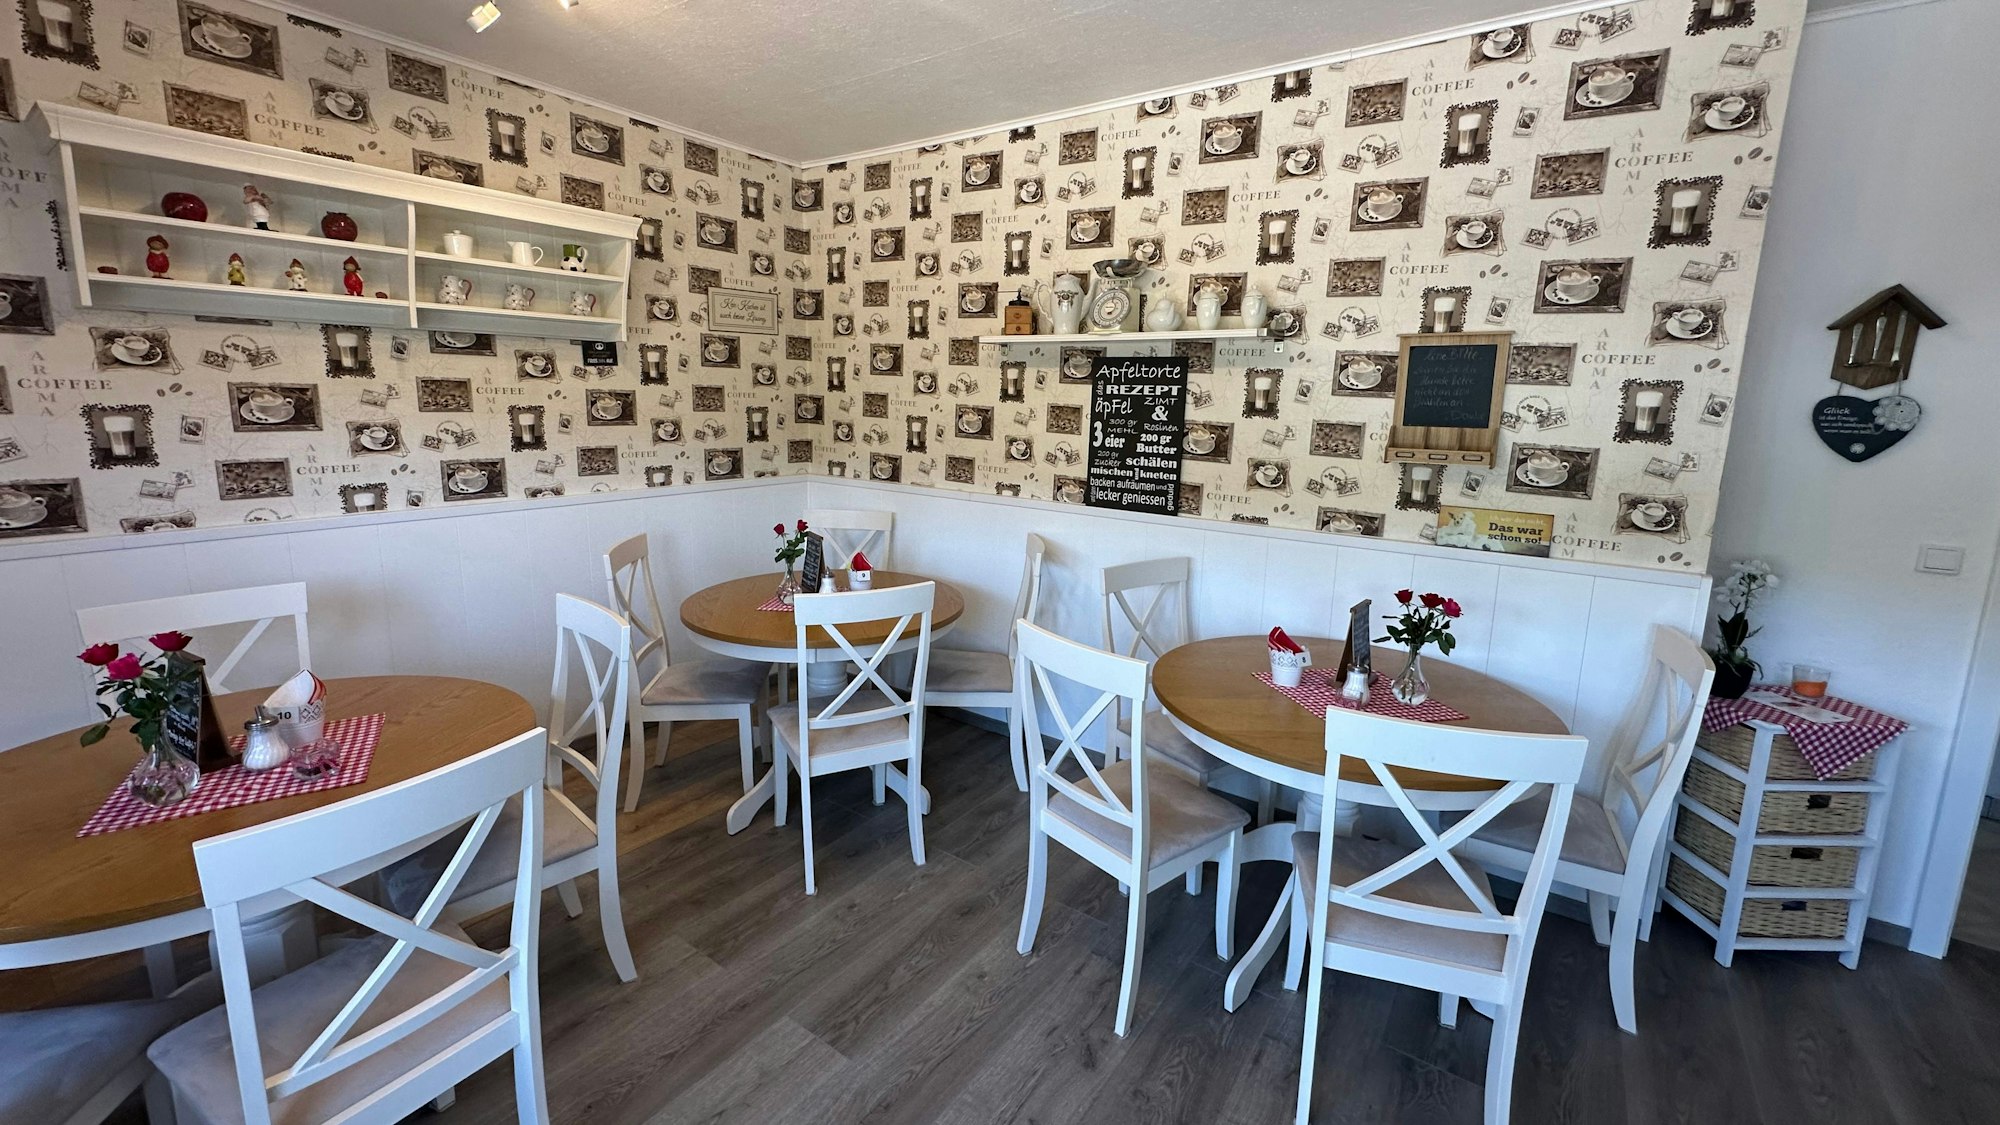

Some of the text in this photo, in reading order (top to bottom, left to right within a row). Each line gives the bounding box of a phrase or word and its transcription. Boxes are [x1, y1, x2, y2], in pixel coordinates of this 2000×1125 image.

[451, 78, 504, 100] COFFEE
[1412, 78, 1475, 96] COFFEE
[254, 113, 326, 138] COFFEE
[1101, 129, 1141, 142] COFFEE
[1615, 151, 1694, 168] COFFEE
[1622, 127, 1644, 195] AROMA
[0, 167, 47, 183] OFF
[608, 191, 648, 207] COFFEE
[1232, 190, 1281, 202] COFFEE
[985, 215, 1018, 224] COFFEE
[1389, 265, 1449, 275] COFFEE
[628, 326, 653, 335] FFEE
[1219, 348, 1266, 357] COFFEE
[1581, 354, 1656, 364] COFFEE
[1590, 328, 1609, 390] AROMA
[1096, 361, 1181, 383] Apfeltorte
[18, 378, 113, 390] COFFEE
[31, 350, 56, 416] AROMA
[1096, 380, 1104, 395] das
[476, 387, 525, 395] COFFEE
[1106, 384, 1182, 396] REZEPT
[1144, 397, 1178, 405] ZIMT
[1151, 405, 1169, 421] &
[1823, 407, 1851, 415] Glück
[1144, 422, 1179, 432] Rosinen
[1093, 420, 1103, 447] 3
[1140, 433, 1172, 444] 200 gr
[1104, 434, 1126, 448] eier
[1136, 443, 1177, 454] Butter
[1126, 456, 1177, 469] schälen
[297, 464, 360, 475] COFFEE
[978, 465, 1009, 474] COFFEE
[1091, 467, 1133, 477] mischen
[1140, 469, 1177, 480] kneten
[1090, 476, 1115, 487] backen
[1116, 479, 1156, 491] aufräumen
[1096, 487, 1121, 501] lecker
[1122, 491, 1166, 506] geniessen
[1167, 483, 1175, 511] geduld
[1207, 492, 1252, 504] COFFEE
[1488, 522, 1543, 536] Das war
[1488, 533, 1521, 542] schon
[1552, 534, 1622, 552] COFFEE
[277, 711, 292, 720] 10
